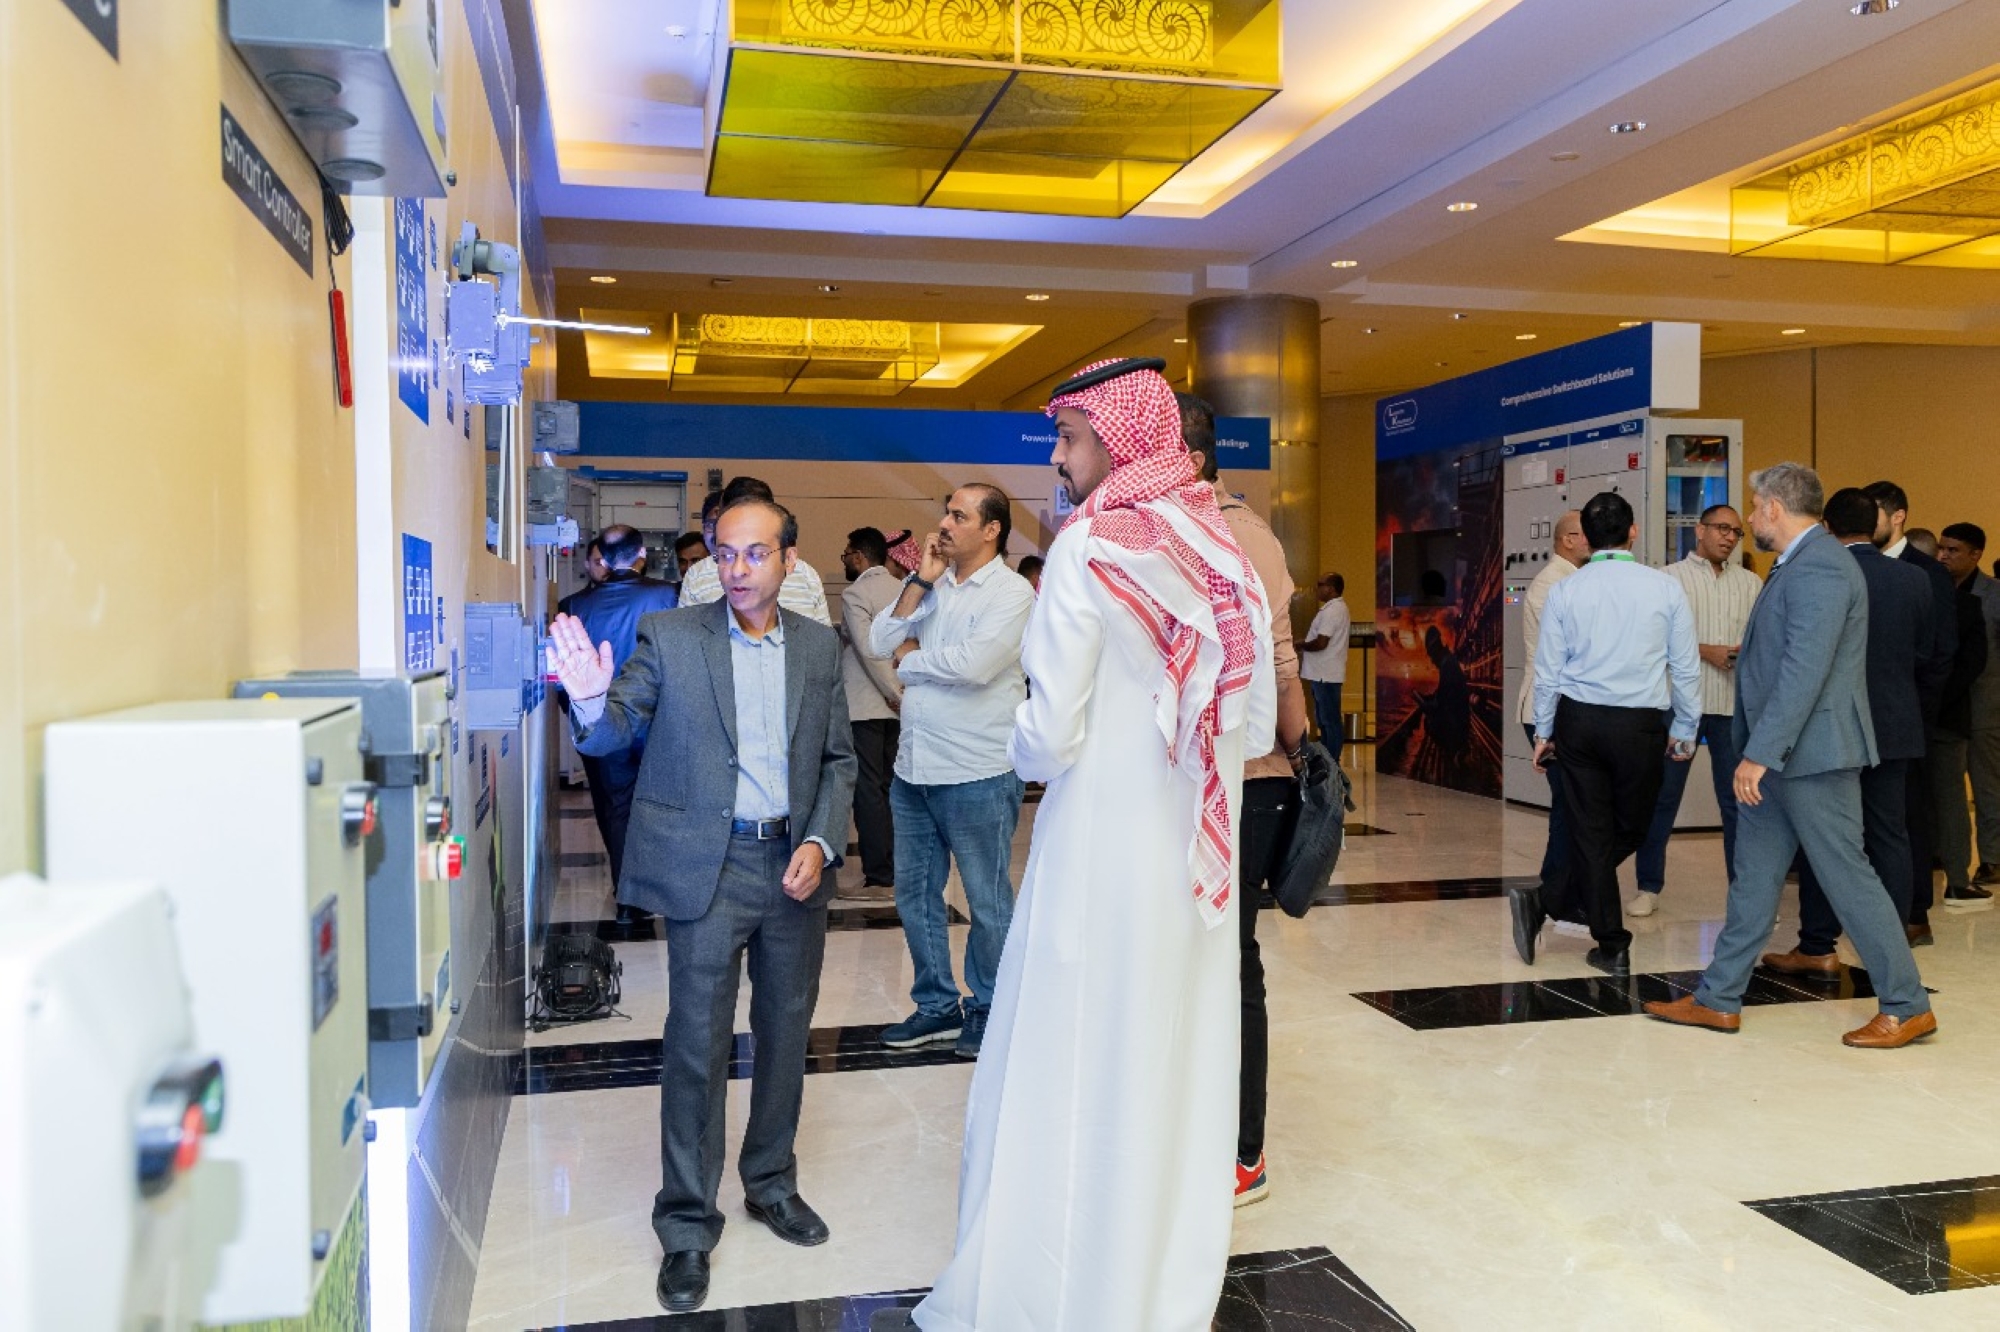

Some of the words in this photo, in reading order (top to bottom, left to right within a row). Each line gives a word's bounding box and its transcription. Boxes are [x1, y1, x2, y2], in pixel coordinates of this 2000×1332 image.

[223, 118, 262, 199] Smart
[263, 171, 311, 255] Controller
[1501, 386, 1553, 407] Comprehensive
[1553, 374, 1598, 395] Switchboard
[1598, 366, 1634, 383] Solutions
[1021, 433, 1058, 443] Powerin
[1215, 438, 1250, 449] uildings
